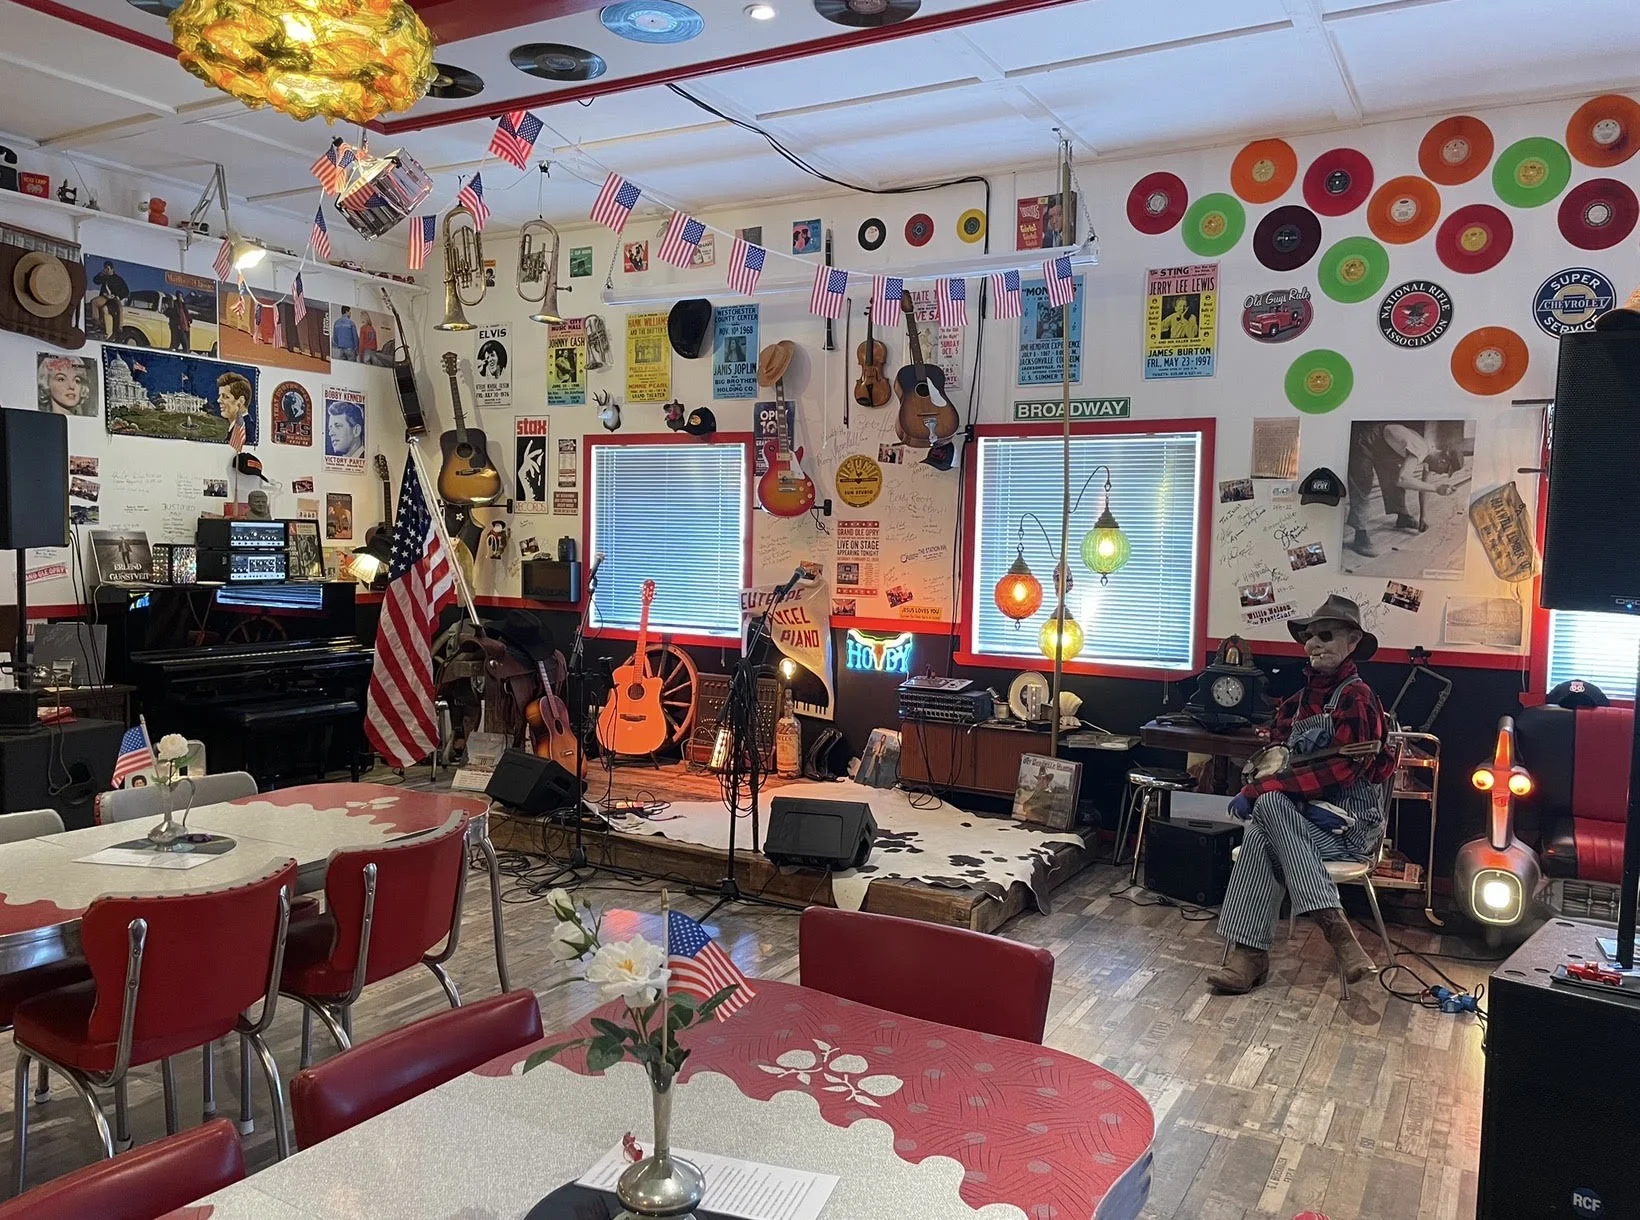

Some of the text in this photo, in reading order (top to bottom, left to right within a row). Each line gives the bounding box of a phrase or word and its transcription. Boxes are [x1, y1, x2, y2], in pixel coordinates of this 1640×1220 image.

[1160, 267, 1189, 276] STING
[1149, 281, 1172, 296] JERRY
[1176, 280, 1188, 294] LEE
[1192, 276, 1214, 292] LEWIS
[1550, 274, 1600, 290] SUPER
[1244, 286, 1310, 308] Old Guys Rule
[1381, 283, 1450, 318] NATIONAL RIFLE
[1544, 298, 1606, 310] CHEVROLET
[717, 308, 756, 316] WESTCHESTER
[714, 315, 735, 323] COUNTY
[480, 329, 506, 339] ELVIS
[740, 326, 753, 334] 1968
[1384, 320, 1448, 346] ASSOCIATION
[549, 337, 585, 348] JOHNNY CASH
[1051, 341, 1080, 349] EXPEENCE
[1148, 348, 1211, 357] JAMES BURTON
[1020, 357, 1053, 366] JACKSONVILLE
[1164, 358, 1178, 366] MAY
[1182, 357, 1190, 366] 23
[1196, 356, 1211, 366] 1997
[714, 362, 757, 375] JANIS JOPLIN
[325, 390, 342, 400] BOBBY
[344, 392, 365, 403] KENNEDY
[1018, 401, 1125, 418] BROADWAY
[325, 456, 347, 464] VICTORY
[837, 540, 879, 550] LIVE ON STAGE
[26, 572, 37, 581] AND
[741, 588, 805, 610] EUTEPE
[1246, 604, 1292, 620] Willie Nelson
[780, 630, 819, 648] PIANO
[846, 639, 912, 672] HODY
[1573, 1192, 1601, 1212] RCF
